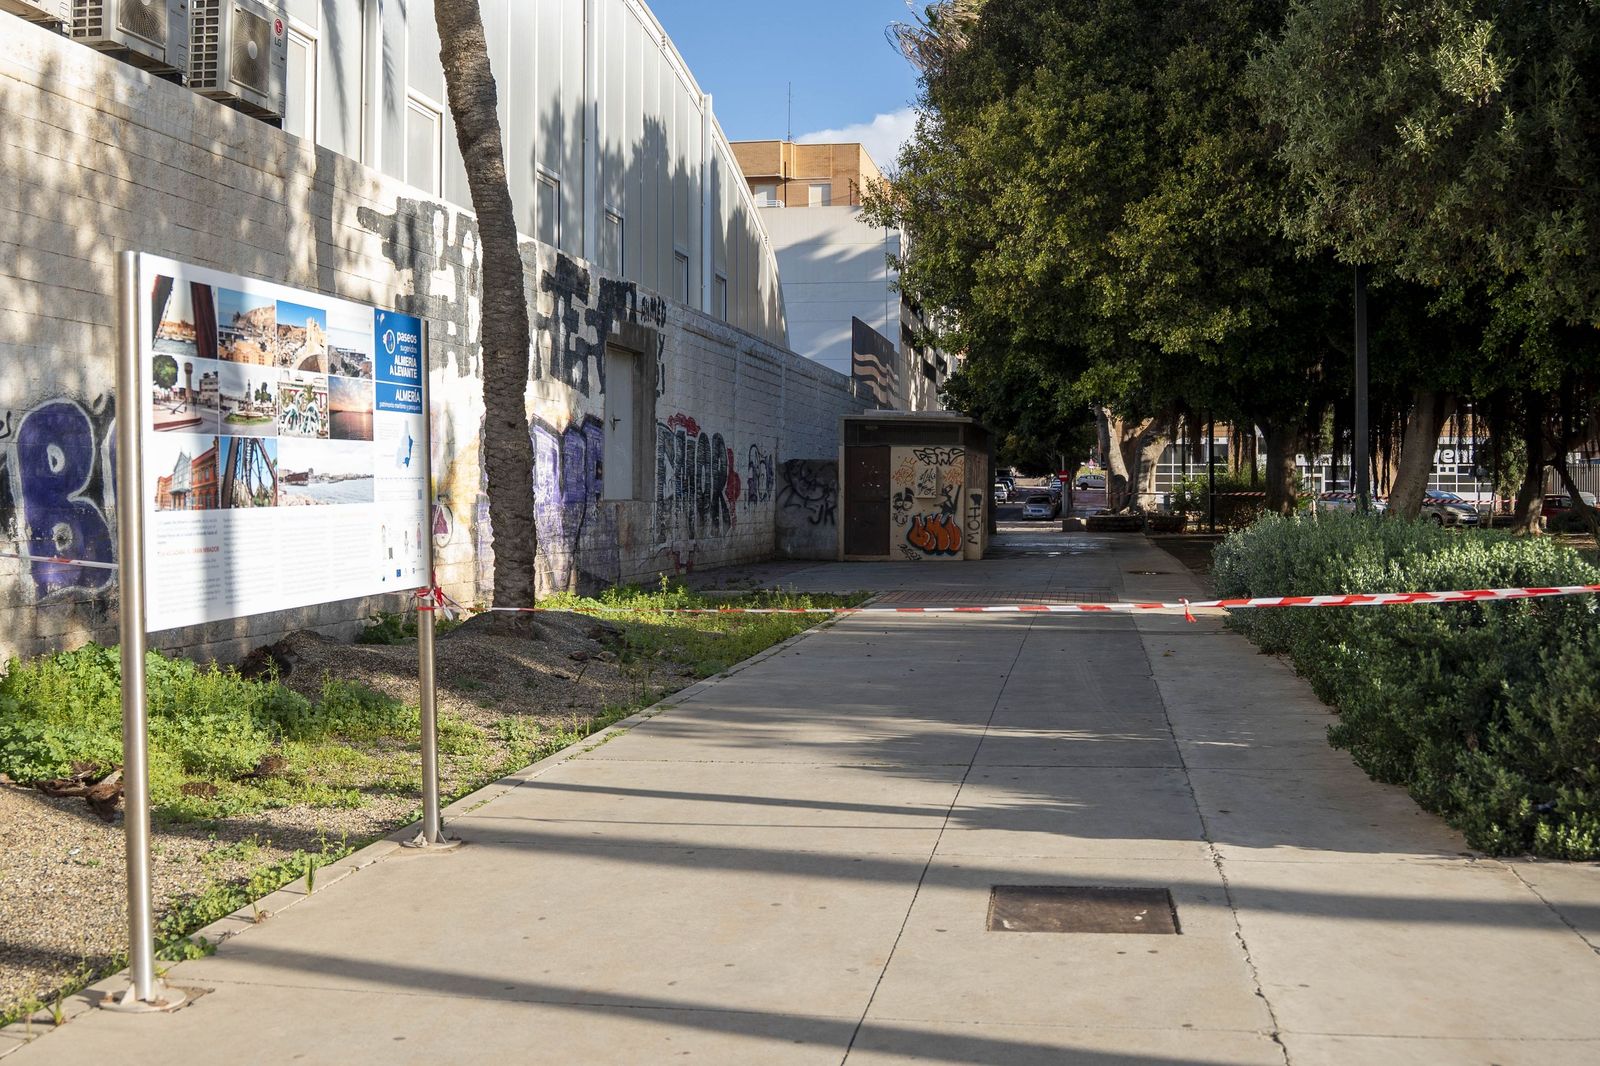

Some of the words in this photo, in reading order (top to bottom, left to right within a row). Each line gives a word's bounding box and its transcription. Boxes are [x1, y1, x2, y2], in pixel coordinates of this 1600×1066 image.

[275, 37, 282, 47] LG
[396, 331, 417, 344] paseos
[394, 354, 418, 368] ALMERÍA
[389, 365, 394, 376] A
[394, 366, 418, 379] LEVANTE
[395, 388, 421, 402] ALMERÍA
